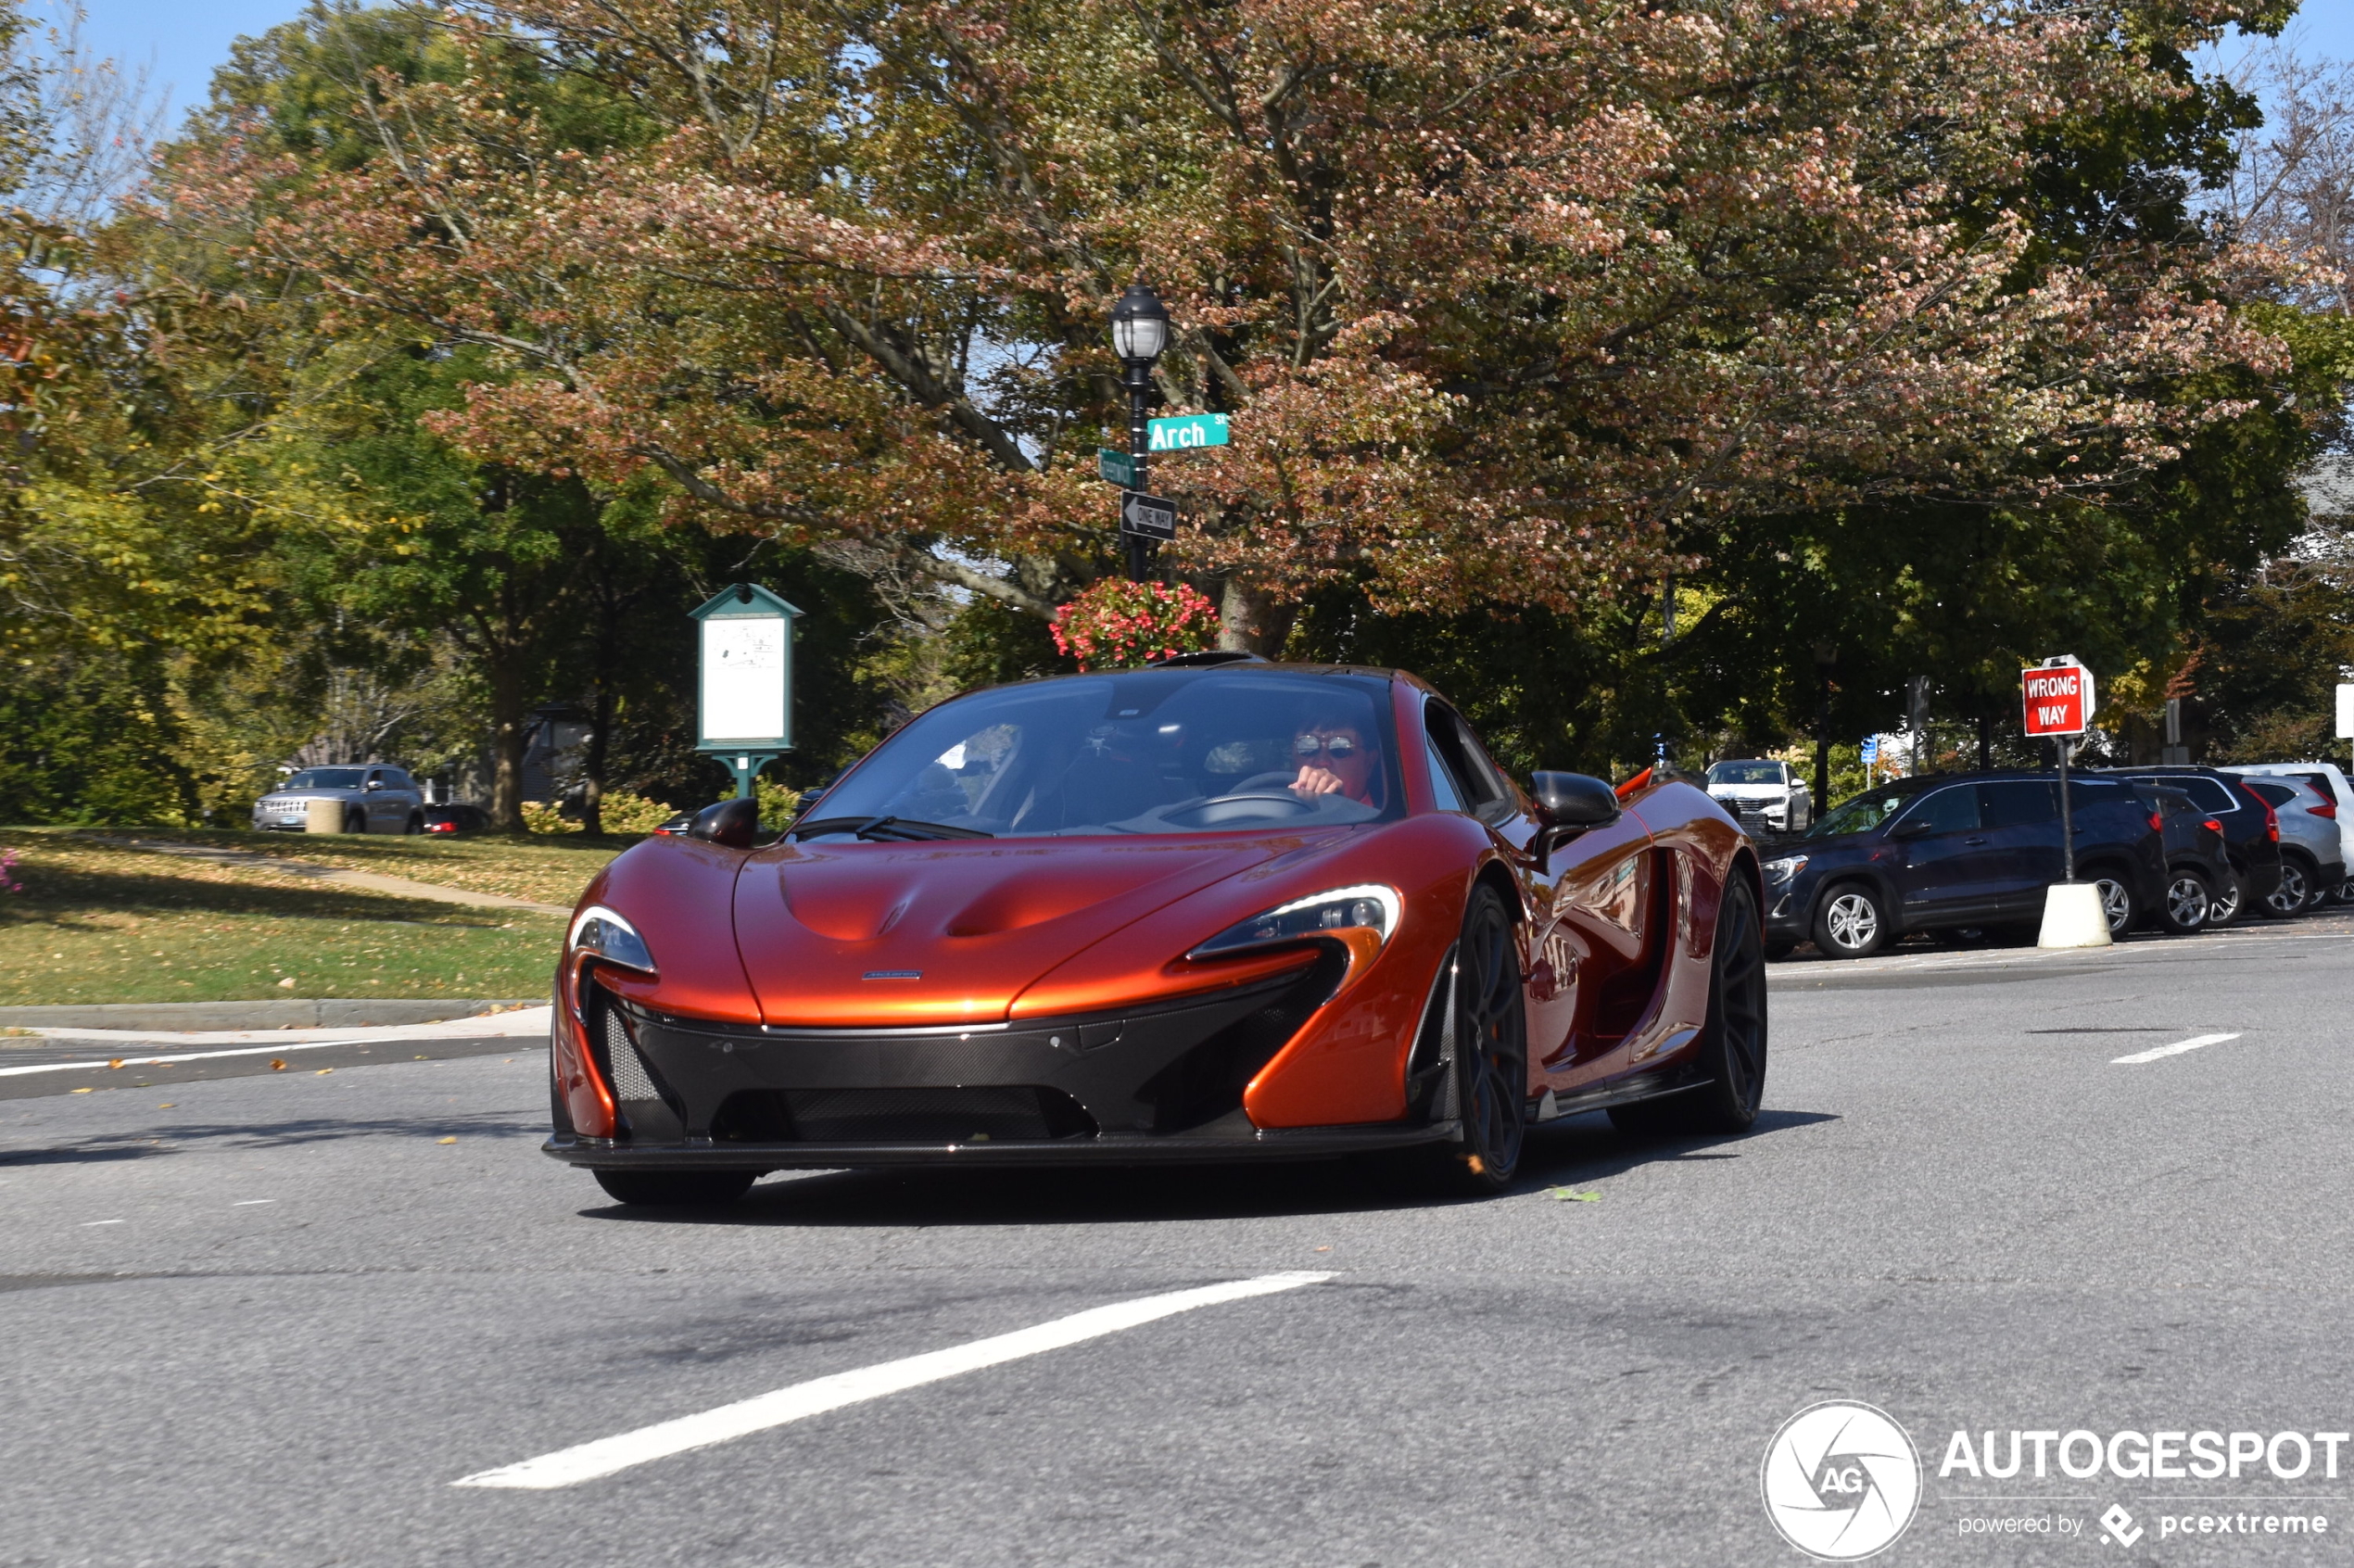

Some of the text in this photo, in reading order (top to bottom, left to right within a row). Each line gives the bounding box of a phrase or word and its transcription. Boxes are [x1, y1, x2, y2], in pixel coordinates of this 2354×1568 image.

[1215, 414, 1226, 424] St
[1151, 422, 1205, 449] Arch
[1137, 507, 1171, 527] ONE WAY
[2028, 676, 2077, 698] WRONG
[2038, 704, 2068, 726] WAY
